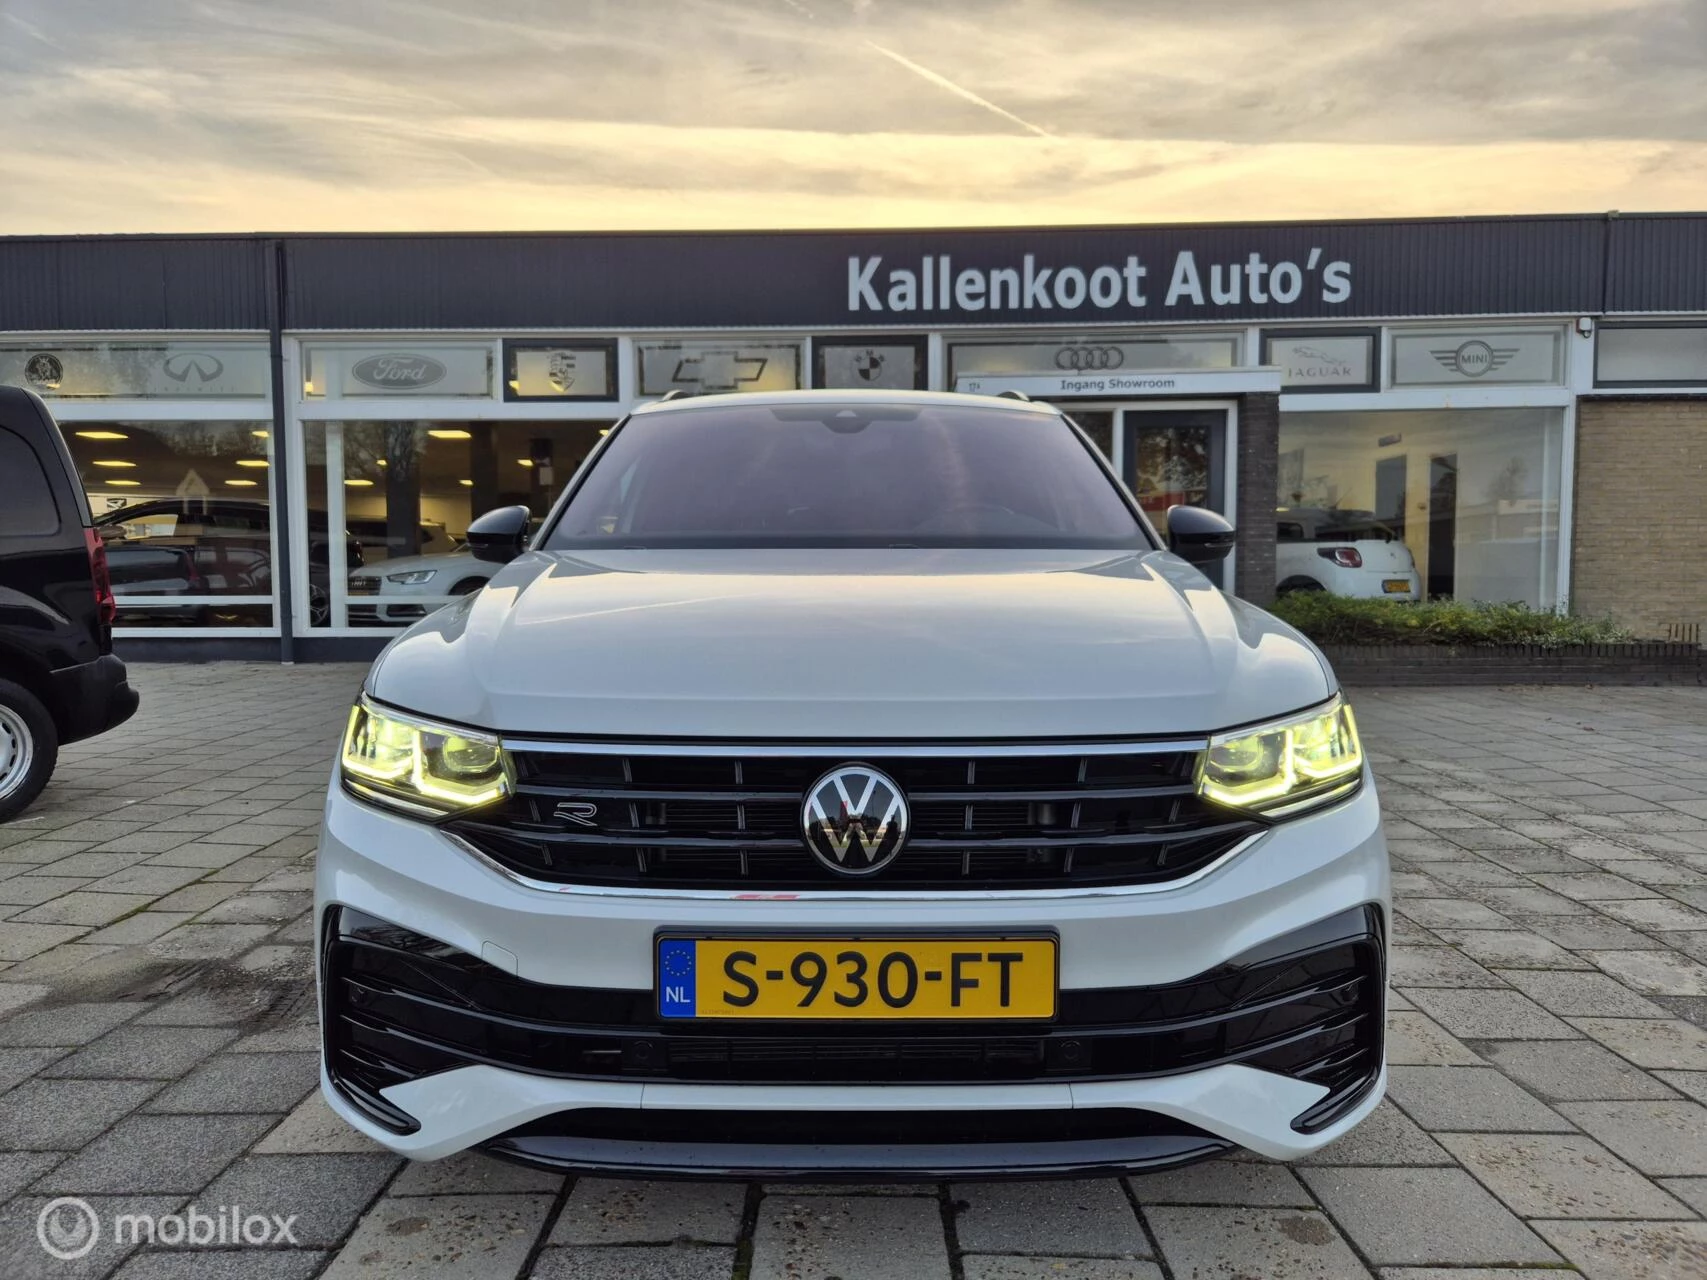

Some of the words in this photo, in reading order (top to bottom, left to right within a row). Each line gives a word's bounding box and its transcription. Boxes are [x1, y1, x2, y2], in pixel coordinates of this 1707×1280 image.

[847, 254, 1147, 312] Kallenkoot
[1164, 248, 1352, 306] Auto's
[373, 357, 427, 380] Ford
[1461, 353, 1488, 365] MINI
[1060, 379, 1105, 392] Ingang
[1107, 378, 1175, 389] Showroom
[722, 950, 1024, 1008] S-930-FT
[665, 986, 691, 1003] NL
